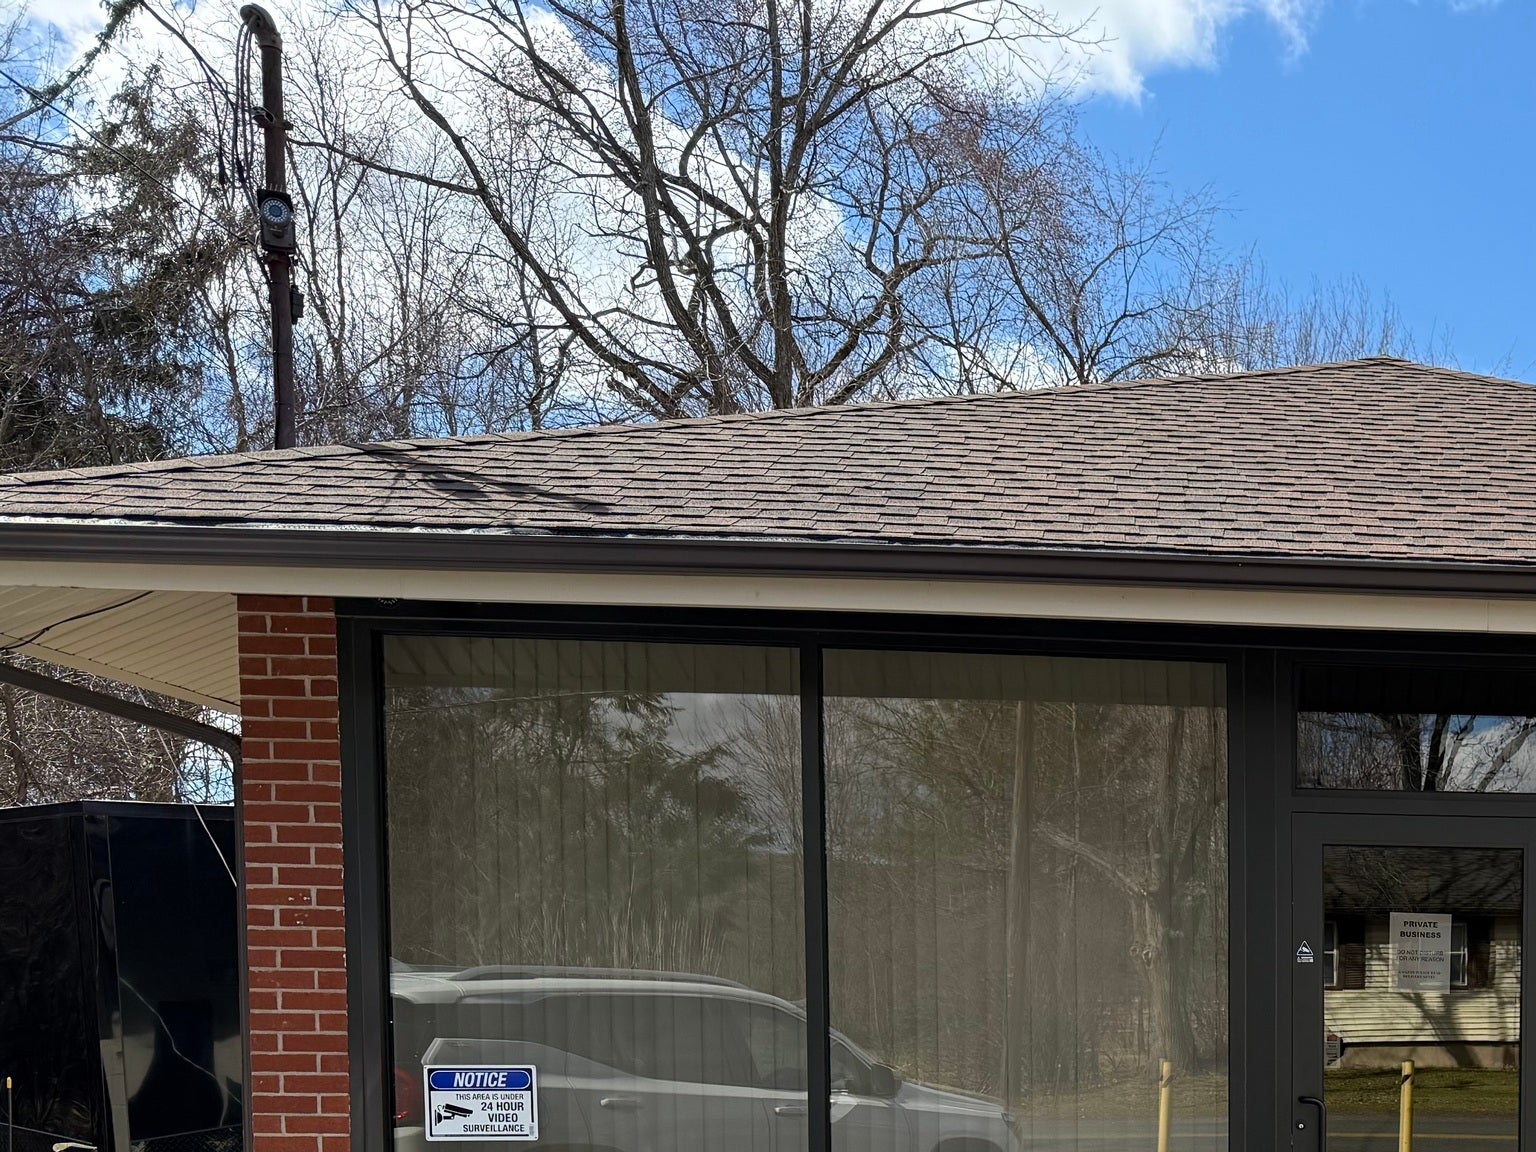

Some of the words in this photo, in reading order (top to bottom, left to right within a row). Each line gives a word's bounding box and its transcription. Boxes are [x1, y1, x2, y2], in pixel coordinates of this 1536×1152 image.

[1400, 930, 1441, 938] BUSINESS
[453, 1072, 508, 1087] NOTICE
[480, 1102, 493, 1111] 24
[496, 1102, 524, 1111] HOUR
[488, 1113, 518, 1122] VIDEO
[463, 1124, 525, 1132] SURVEILLANCE
